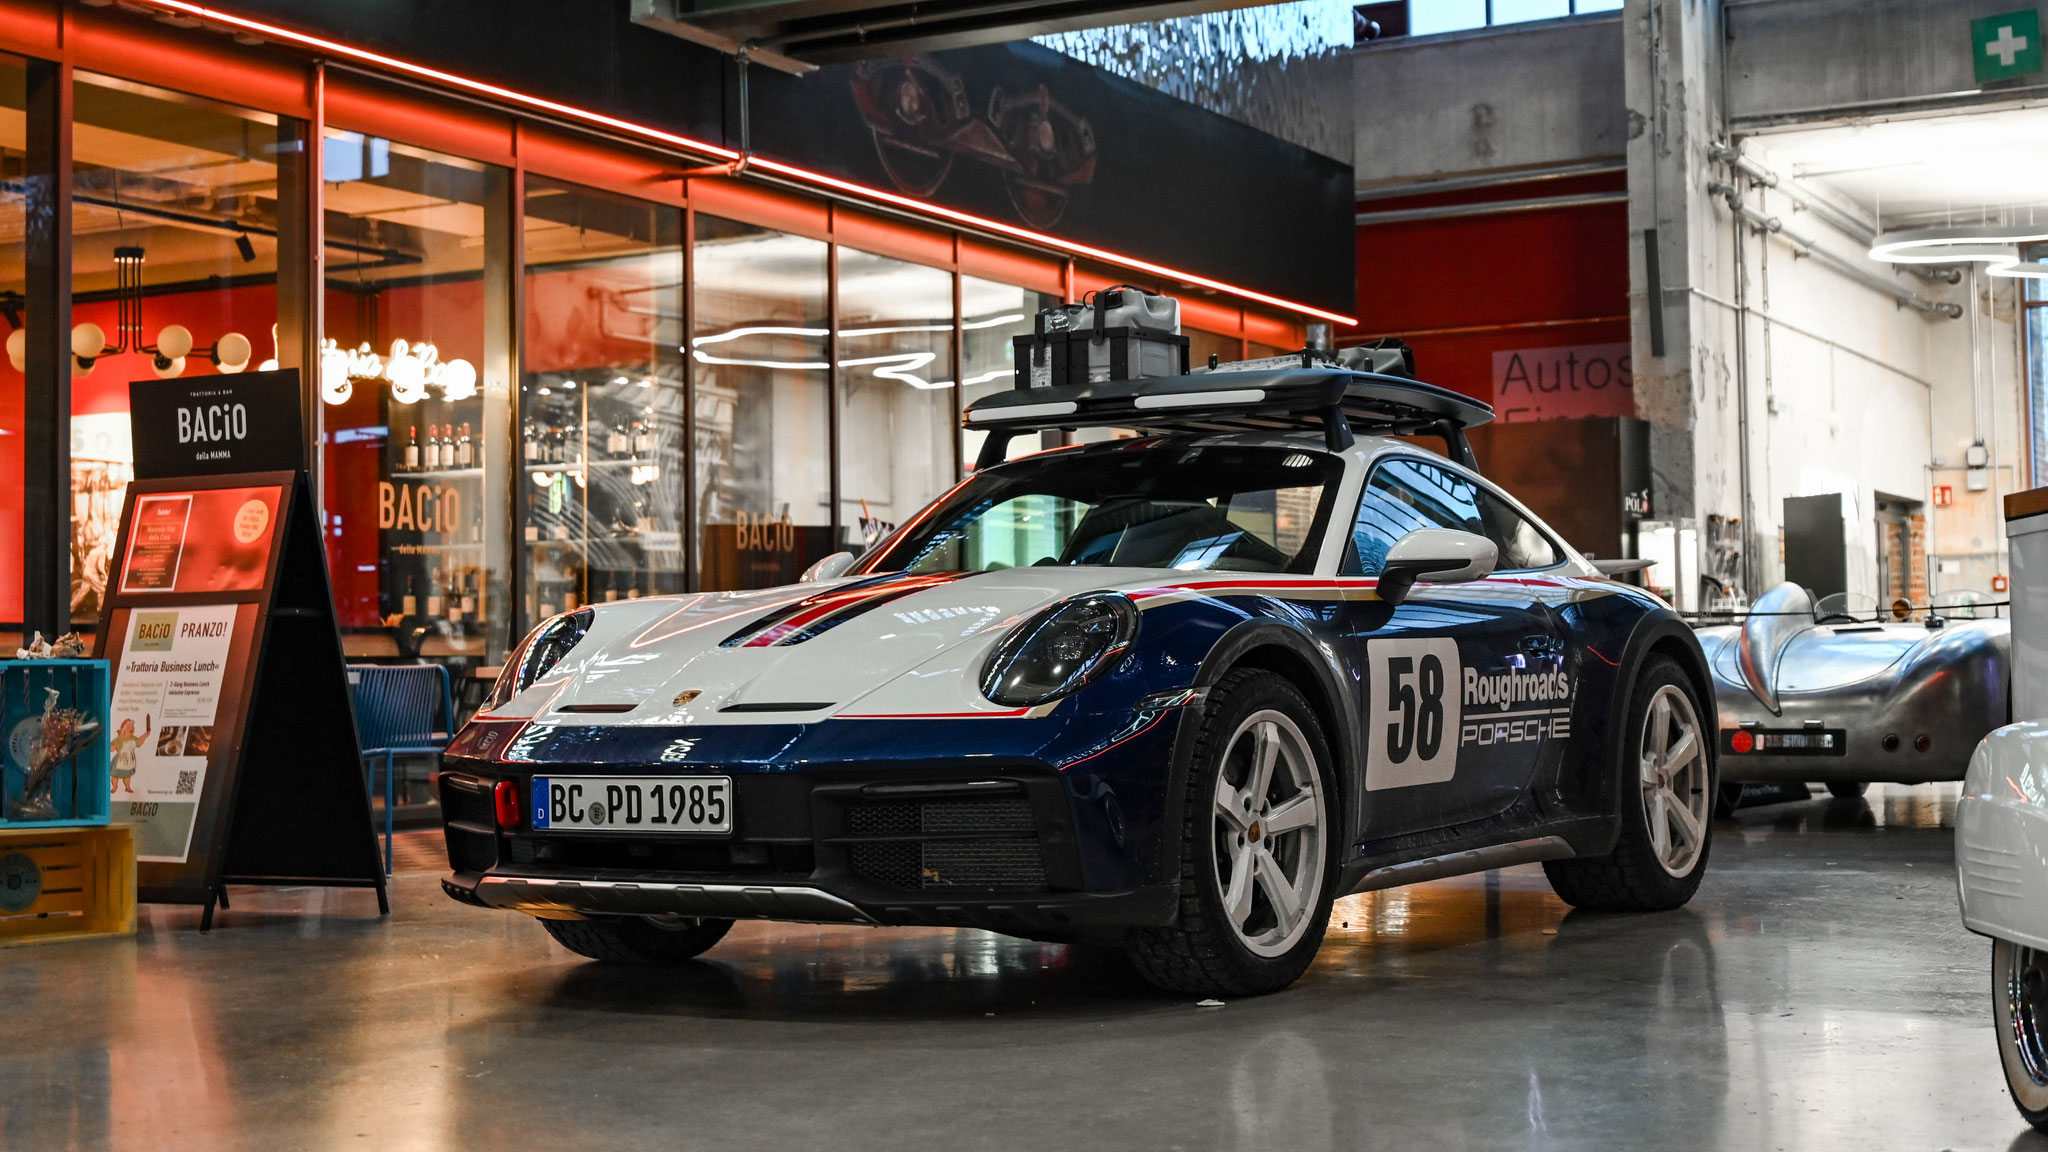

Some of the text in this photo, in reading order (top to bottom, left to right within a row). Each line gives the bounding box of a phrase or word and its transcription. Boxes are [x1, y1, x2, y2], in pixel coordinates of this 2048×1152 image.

[177, 403, 247, 443] BACiO
[196, 450, 232, 461] della MAMMA
[379, 481, 460, 534] BACiO
[138, 621, 228, 639] BACiO PRANZO!
[160, 660, 192, 672] Business
[1463, 664, 1569, 711] Roughroads
[1387, 654, 1444, 764] 58
[1461, 717, 1571, 747] PORSCHE
[537, 808, 544, 819] D
[551, 784, 725, 824] BC PD 1985
